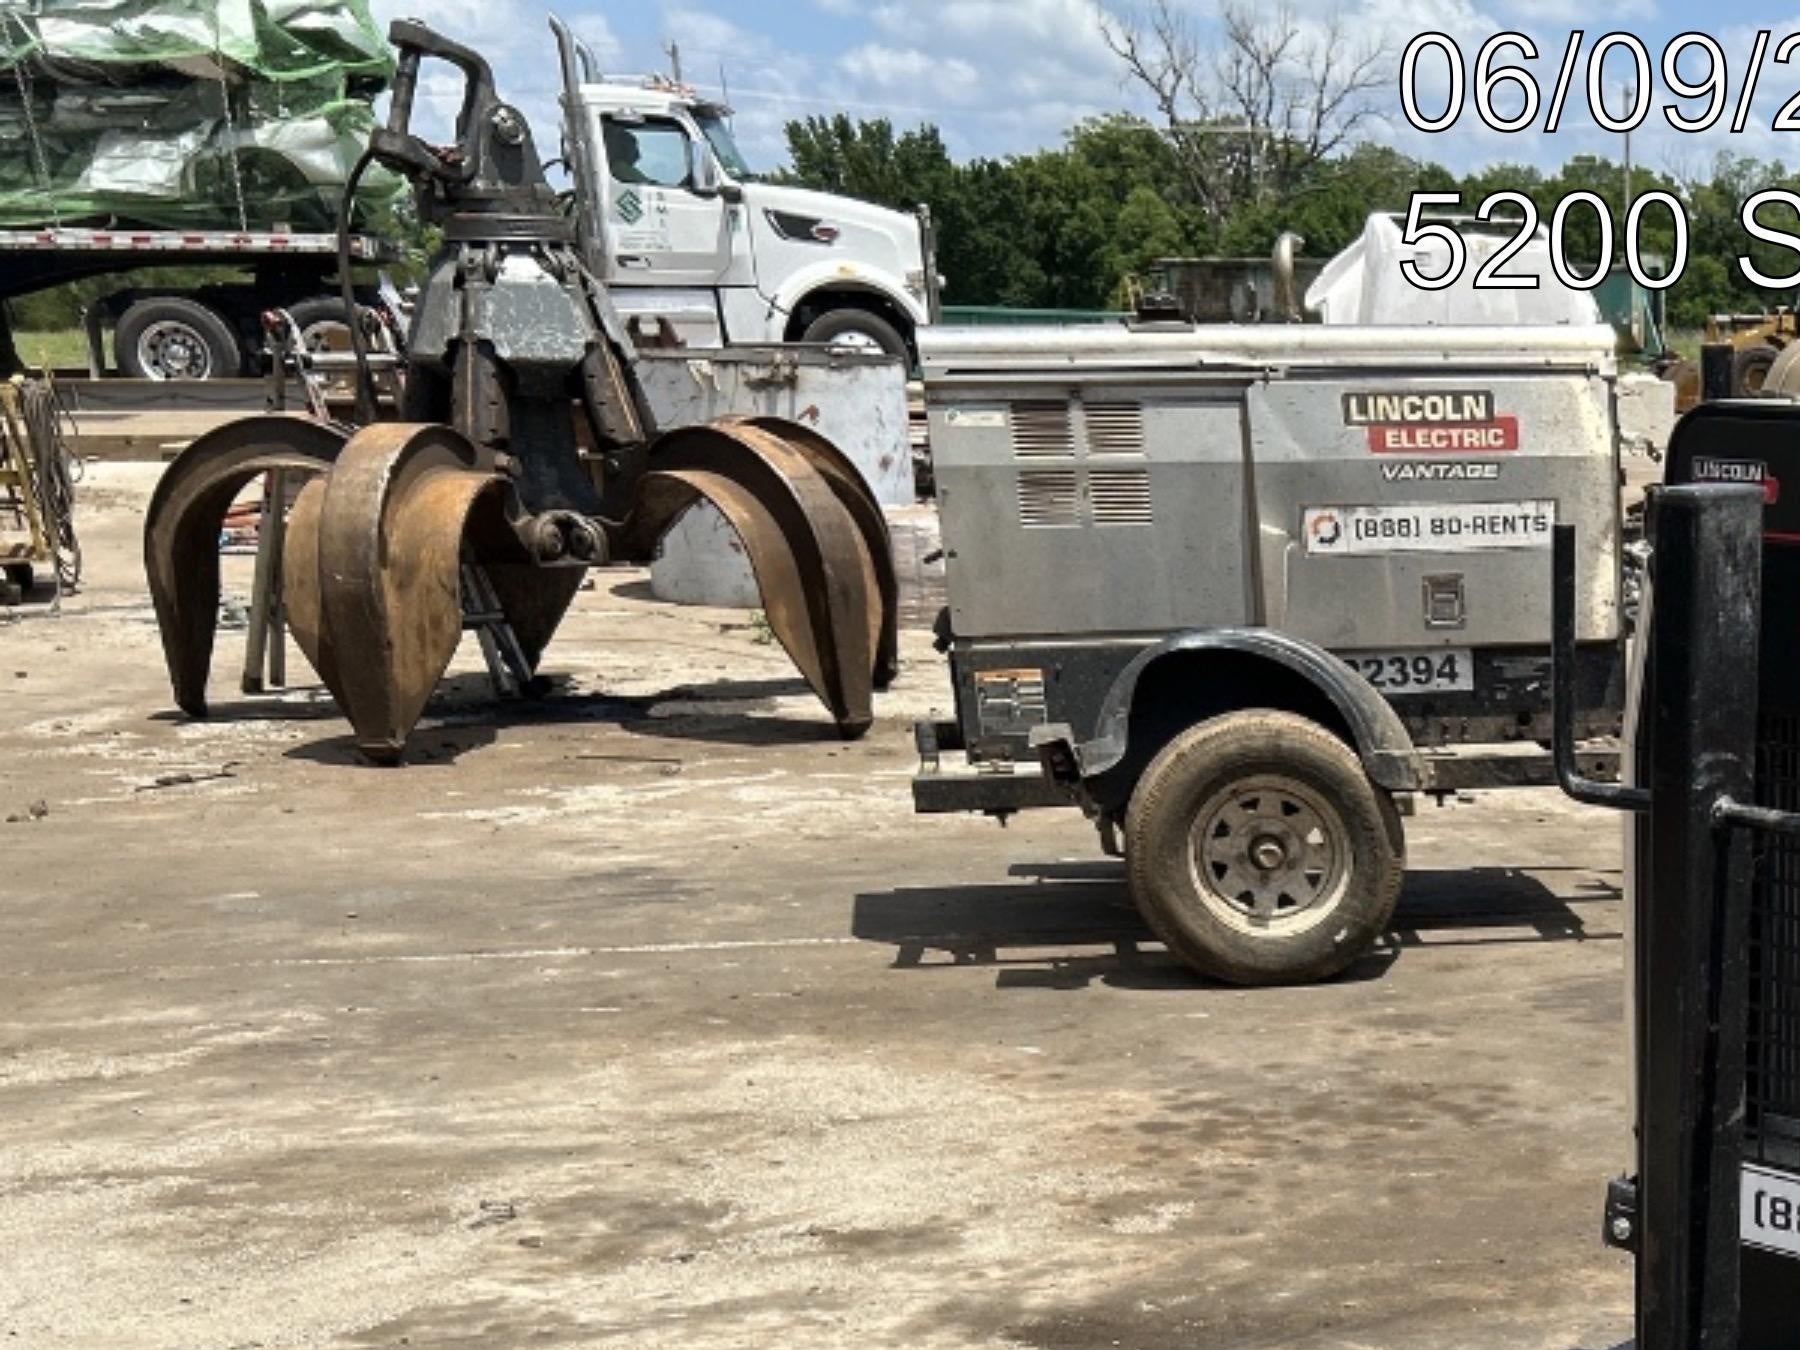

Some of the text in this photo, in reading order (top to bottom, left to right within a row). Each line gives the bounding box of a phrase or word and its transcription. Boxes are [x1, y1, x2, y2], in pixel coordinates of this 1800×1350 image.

[1349, 394, 1487, 422] LINCOLN
[1385, 428, 1506, 449] ELECTRIC
[1381, 462, 1501, 480] VANTAGE
[1430, 513, 1548, 537] 80-RENTS
[1344, 653, 1459, 687] 2394
